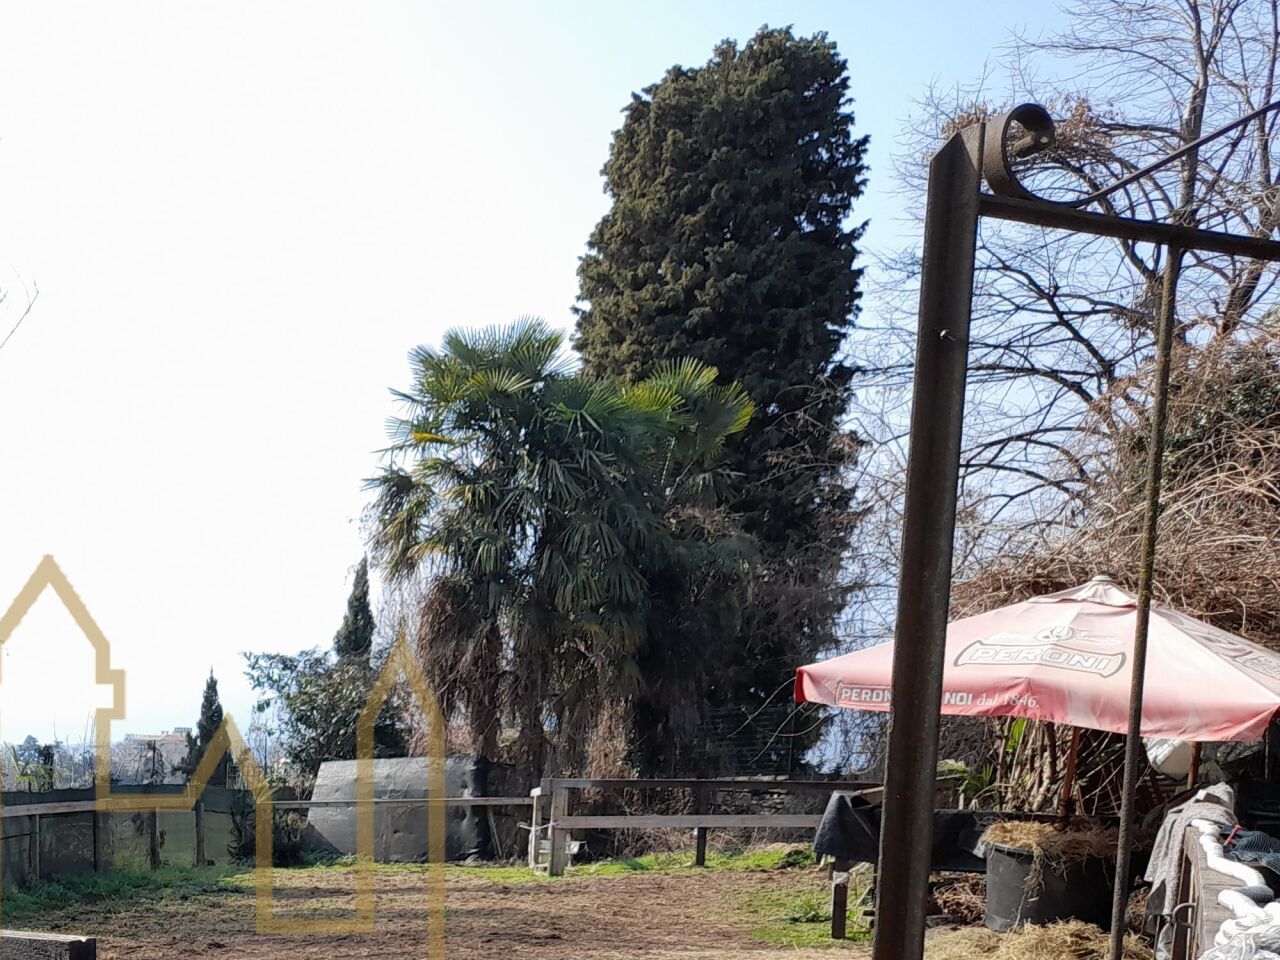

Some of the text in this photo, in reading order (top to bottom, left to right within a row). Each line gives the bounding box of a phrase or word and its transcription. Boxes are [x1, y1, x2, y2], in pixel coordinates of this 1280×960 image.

[969, 647, 1112, 671] PERONI
[841, 688, 892, 702] PERON
[944, 692, 973, 705] NOI
[976, 693, 999, 706] dal
